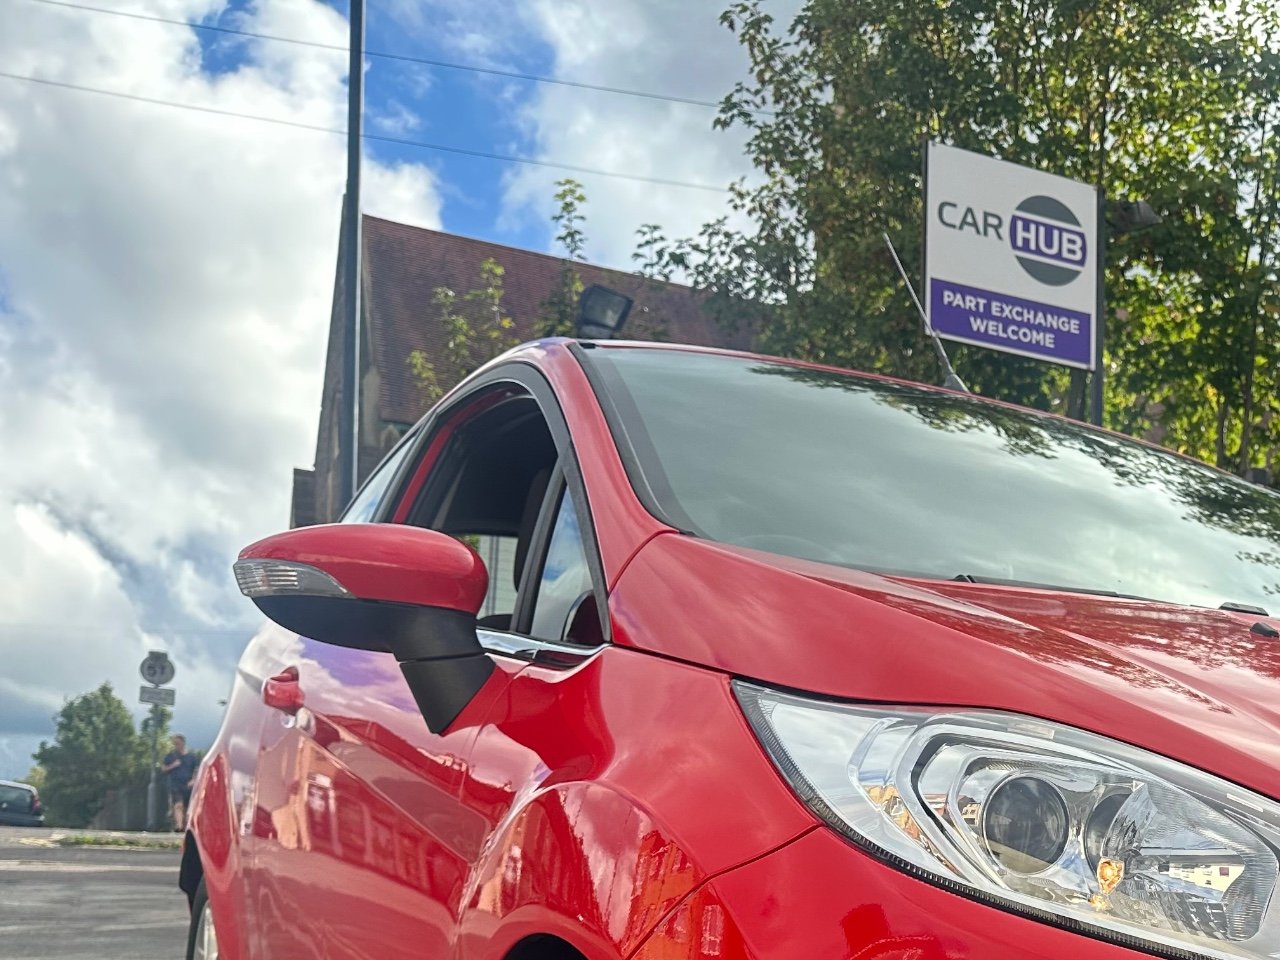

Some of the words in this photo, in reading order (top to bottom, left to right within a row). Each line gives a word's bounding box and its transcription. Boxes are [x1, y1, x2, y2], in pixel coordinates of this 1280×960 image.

[937, 201, 1004, 242] CAR
[1015, 219, 1083, 262] HUB
[942, 289, 988, 313] PART
[991, 303, 1081, 335] EXCHANGE
[969, 316, 1056, 349] WELCOME
